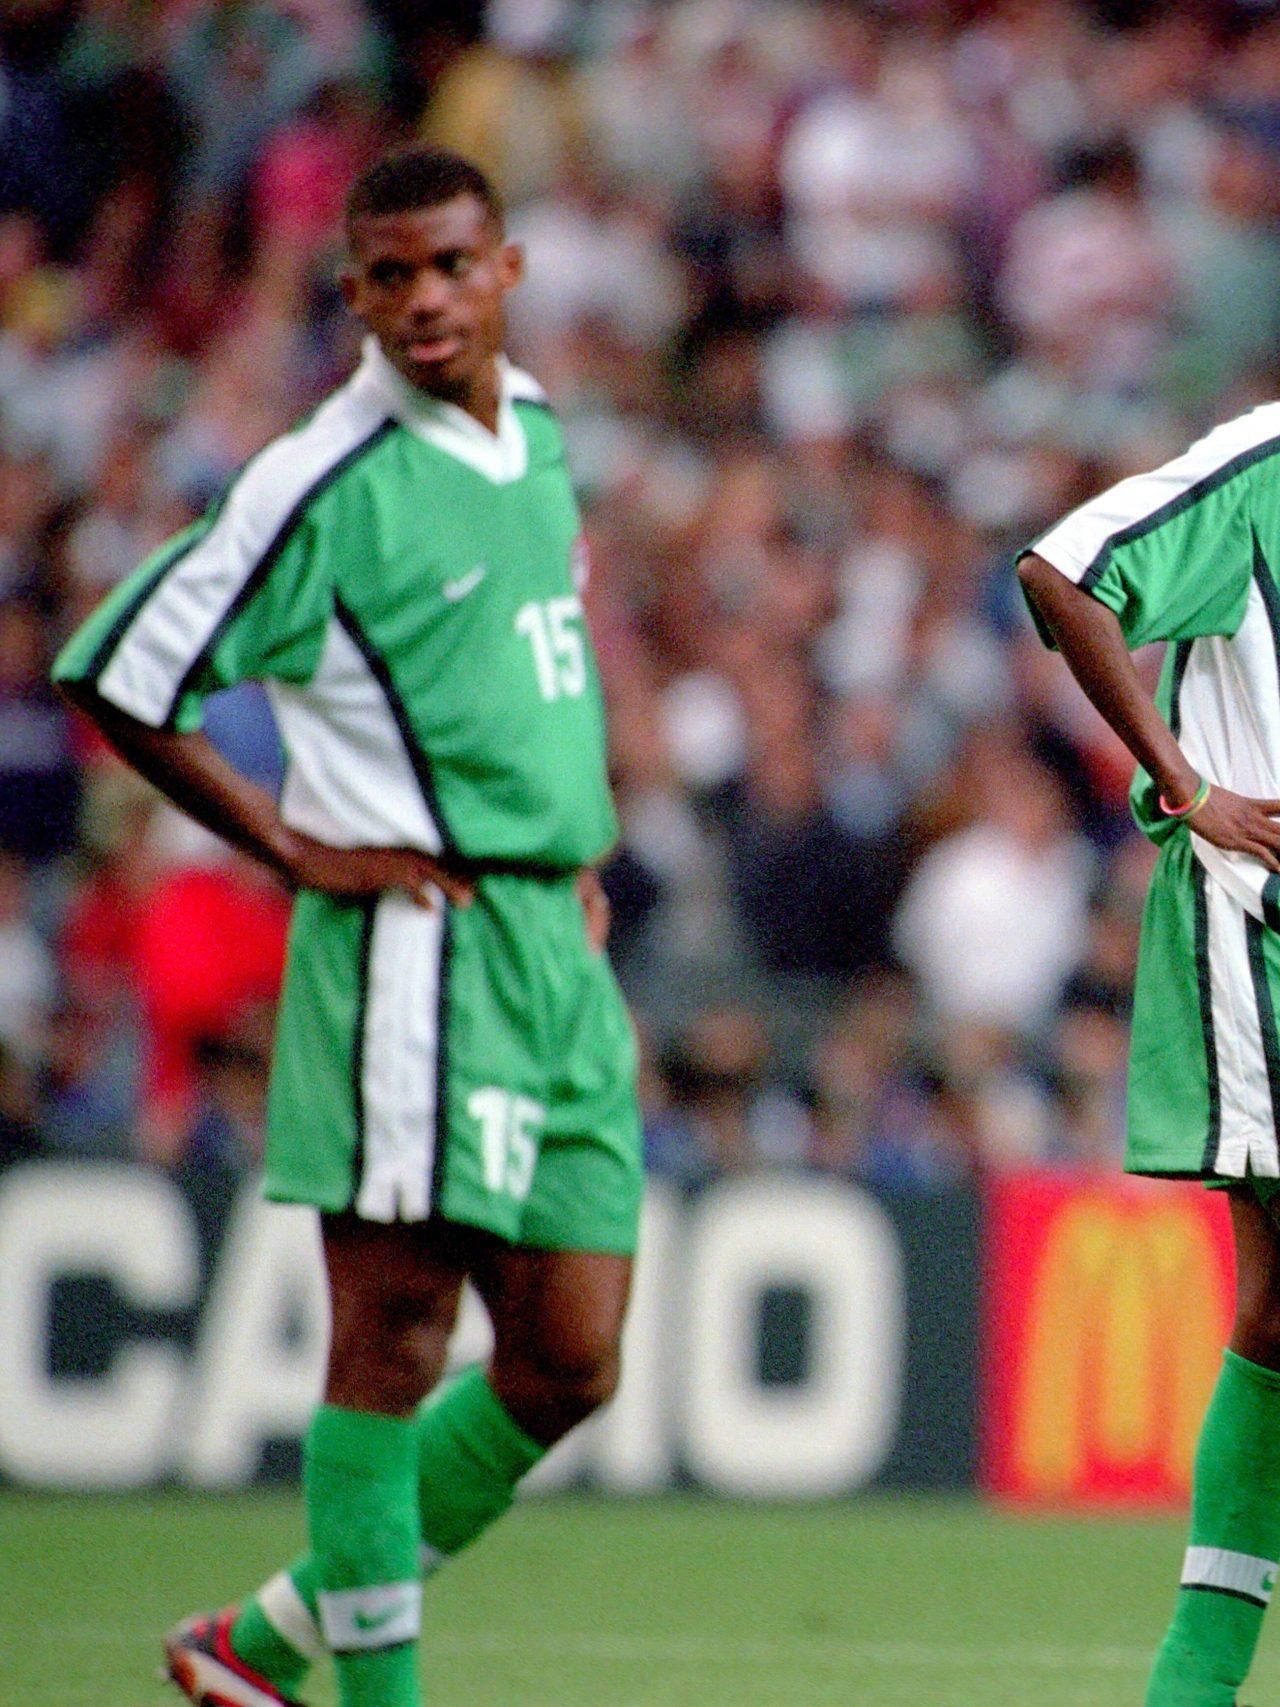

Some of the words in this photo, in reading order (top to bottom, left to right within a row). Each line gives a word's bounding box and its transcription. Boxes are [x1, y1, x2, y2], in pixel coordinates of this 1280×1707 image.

[514, 596, 586, 700] 15
[467, 1086, 546, 1200] 15
[0, 1160, 906, 1497] CAIO
